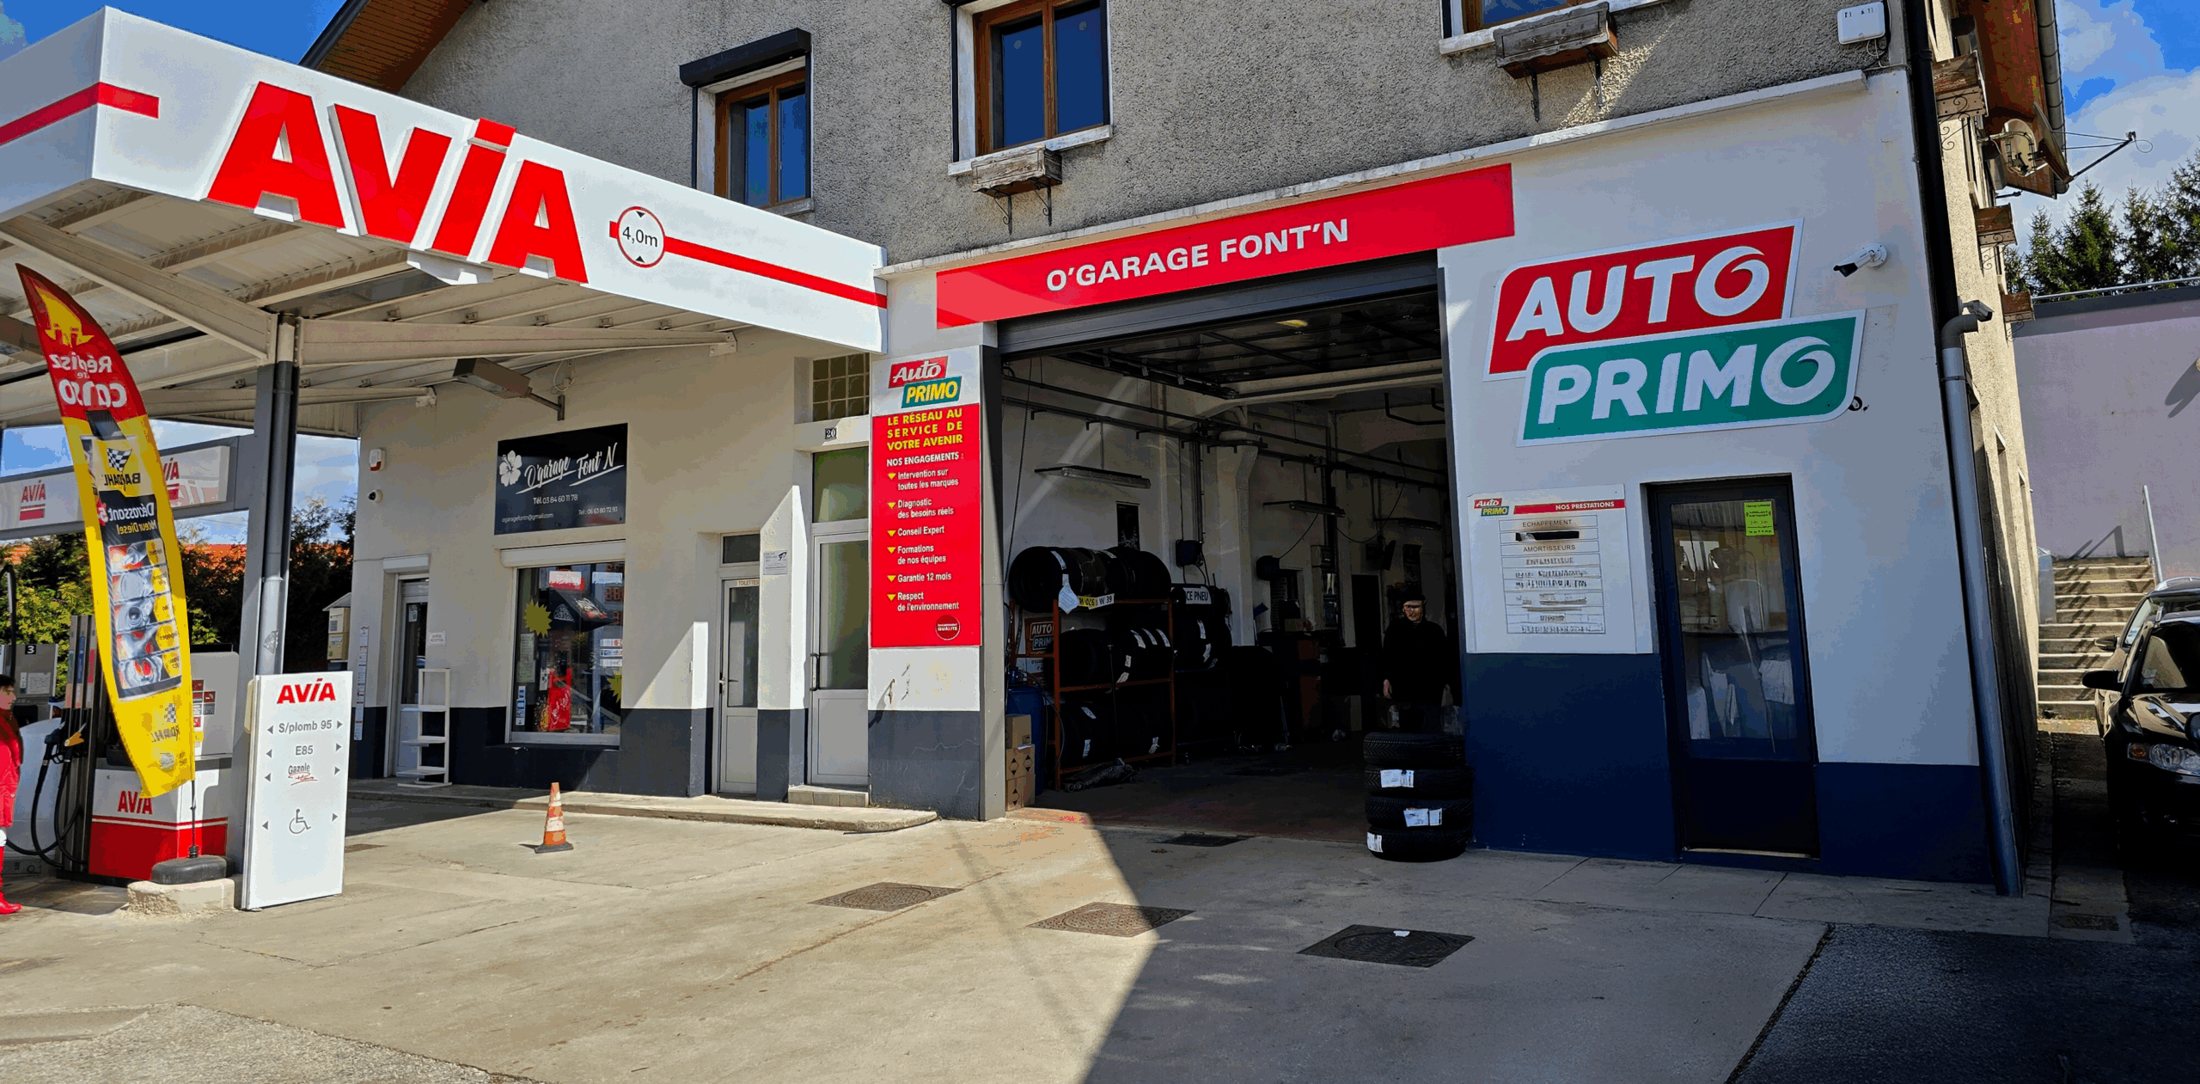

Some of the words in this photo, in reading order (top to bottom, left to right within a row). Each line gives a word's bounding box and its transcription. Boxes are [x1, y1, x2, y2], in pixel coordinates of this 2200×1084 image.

[206, 80, 589, 284] AVIA
[622, 226, 658, 248] 4,0m
[1045, 244, 1209, 292] O'GARAGE
[1220, 218, 1349, 262] FONT'N
[1505, 245, 1770, 342] AUTO
[892, 360, 942, 383] Auto
[1538, 336, 1836, 425] PRIMO
[905, 381, 958, 403] PRIMO
[887, 416, 898, 426] LE
[902, 411, 942, 425] RÉSEAU
[946, 408, 962, 421] AU
[826, 429, 836, 438] 20
[887, 424, 938, 439] SERVICE
[947, 421, 962, 431] DE
[887, 439, 920, 451] VOTRE
[923, 434, 963, 448] AVENIR
[887, 457, 902, 467] NOS
[904, 451, 959, 465] ENGAGEMENTS
[898, 470, 936, 480] Intervention
[937, 469, 949, 477] sur
[21, 480, 46, 503] AVIA
[898, 482, 918, 491] toutes
[930, 479, 959, 489] marques
[898, 499, 932, 509] Diagnostic
[1572, 501, 1615, 509] PRESTATIONS
[897, 510, 910, 519] des
[911, 509, 936, 518] besoins
[897, 527, 922, 536] Conseil
[923, 525, 945, 536] Expert
[898, 544, 934, 554] Formations
[897, 556, 906, 565] de
[920, 554, 947, 565] équipes
[897, 574, 925, 583] Garantie
[926, 573, 934, 582] 12
[935, 572, 952, 581] mois
[898, 592, 924, 602] Respect
[897, 603, 906, 612] de
[907, 601, 960, 611] l'environnement
[1032, 624, 1052, 635] AUTO
[26, 645, 35, 654] 3
[277, 678, 336, 704] AVIA
[278, 721, 318, 734] S/plomb
[320, 720, 332, 730] 95
[295, 745, 314, 756] E85
[117, 790, 153, 815] AVIA
